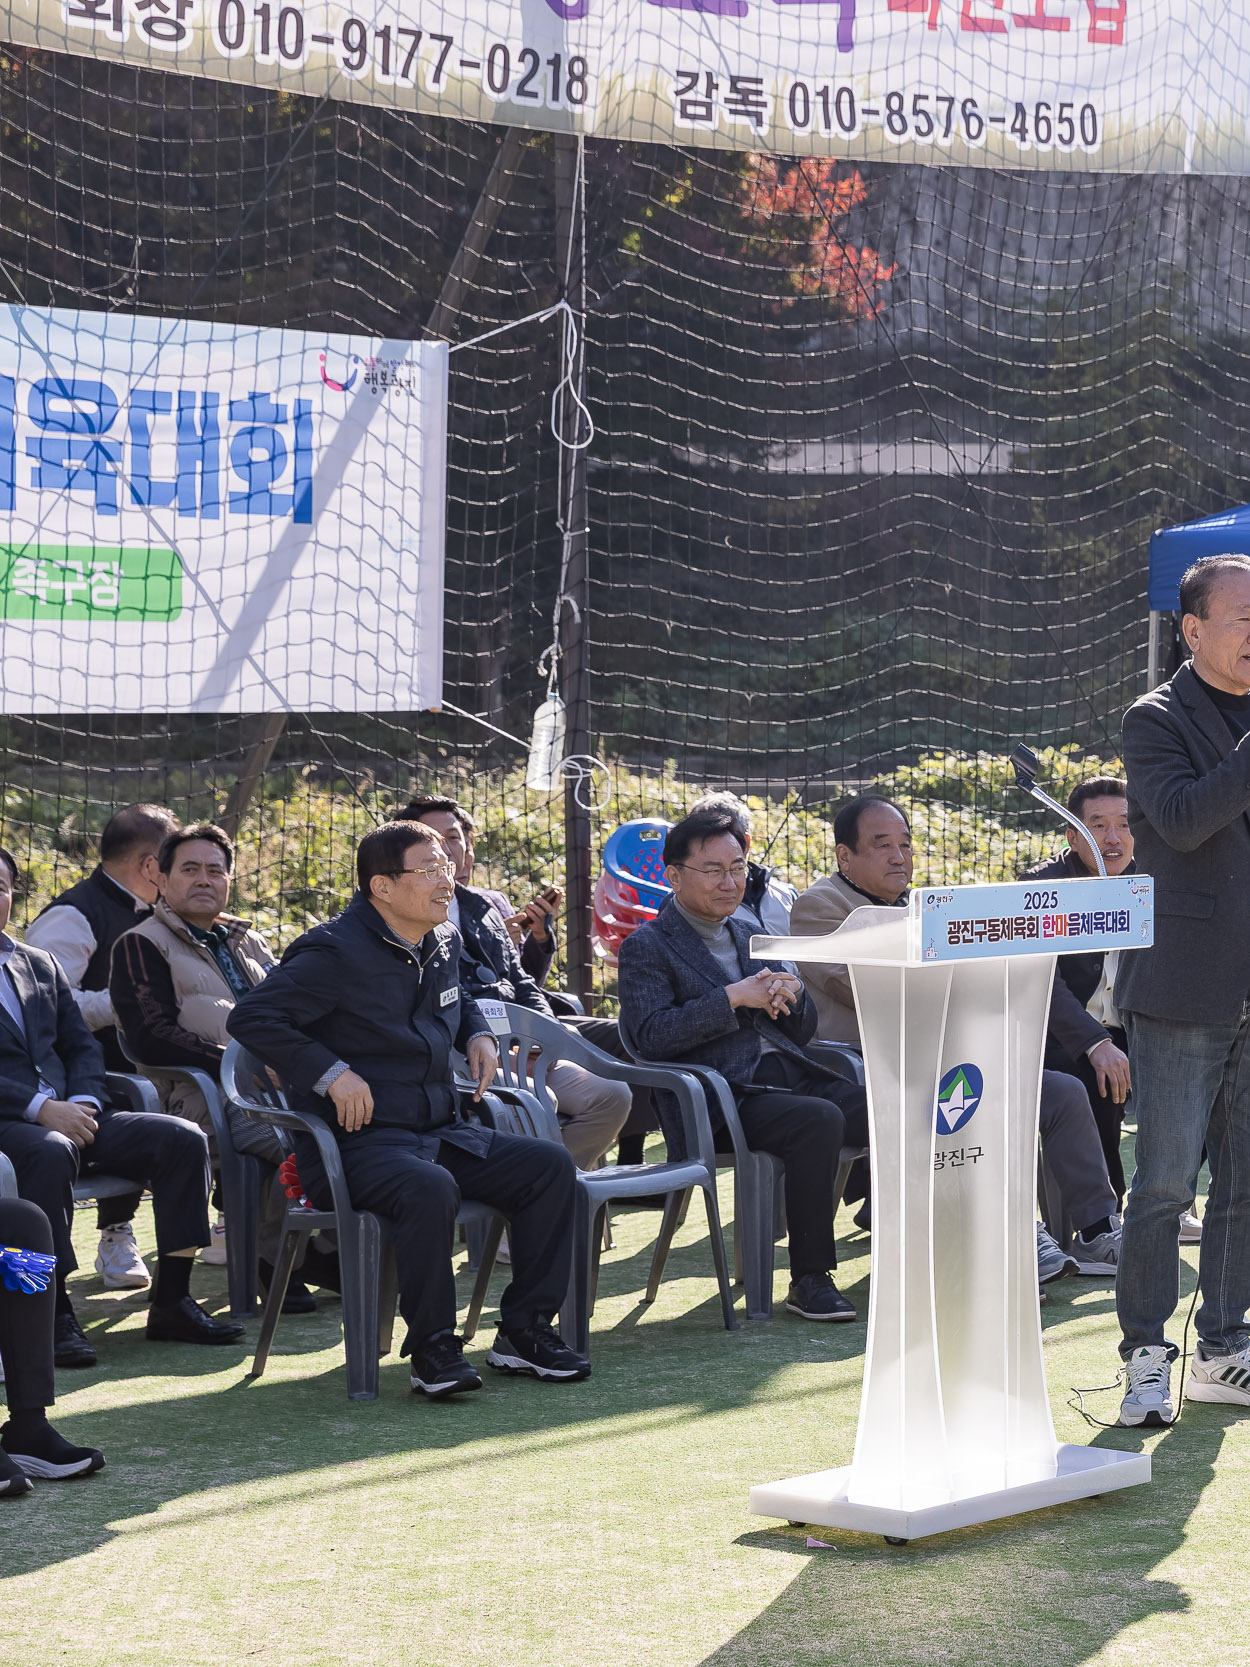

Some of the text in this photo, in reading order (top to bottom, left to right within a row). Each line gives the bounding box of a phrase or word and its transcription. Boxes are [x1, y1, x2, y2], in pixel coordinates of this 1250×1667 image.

[218, 0, 589, 105] 010-9177-0218
[674, 70, 1098, 146] 감독 010-8576-4650
[0, 375, 313, 524] 육대회
[12, 558, 124, 606] 족구장
[1023, 891, 1059, 910] 2025
[947, 909, 1130, 945] 광진구동체육회 한마음체육대회
[480, 1007, 503, 1016] 육회장
[934, 1146, 985, 1171] 광진구
